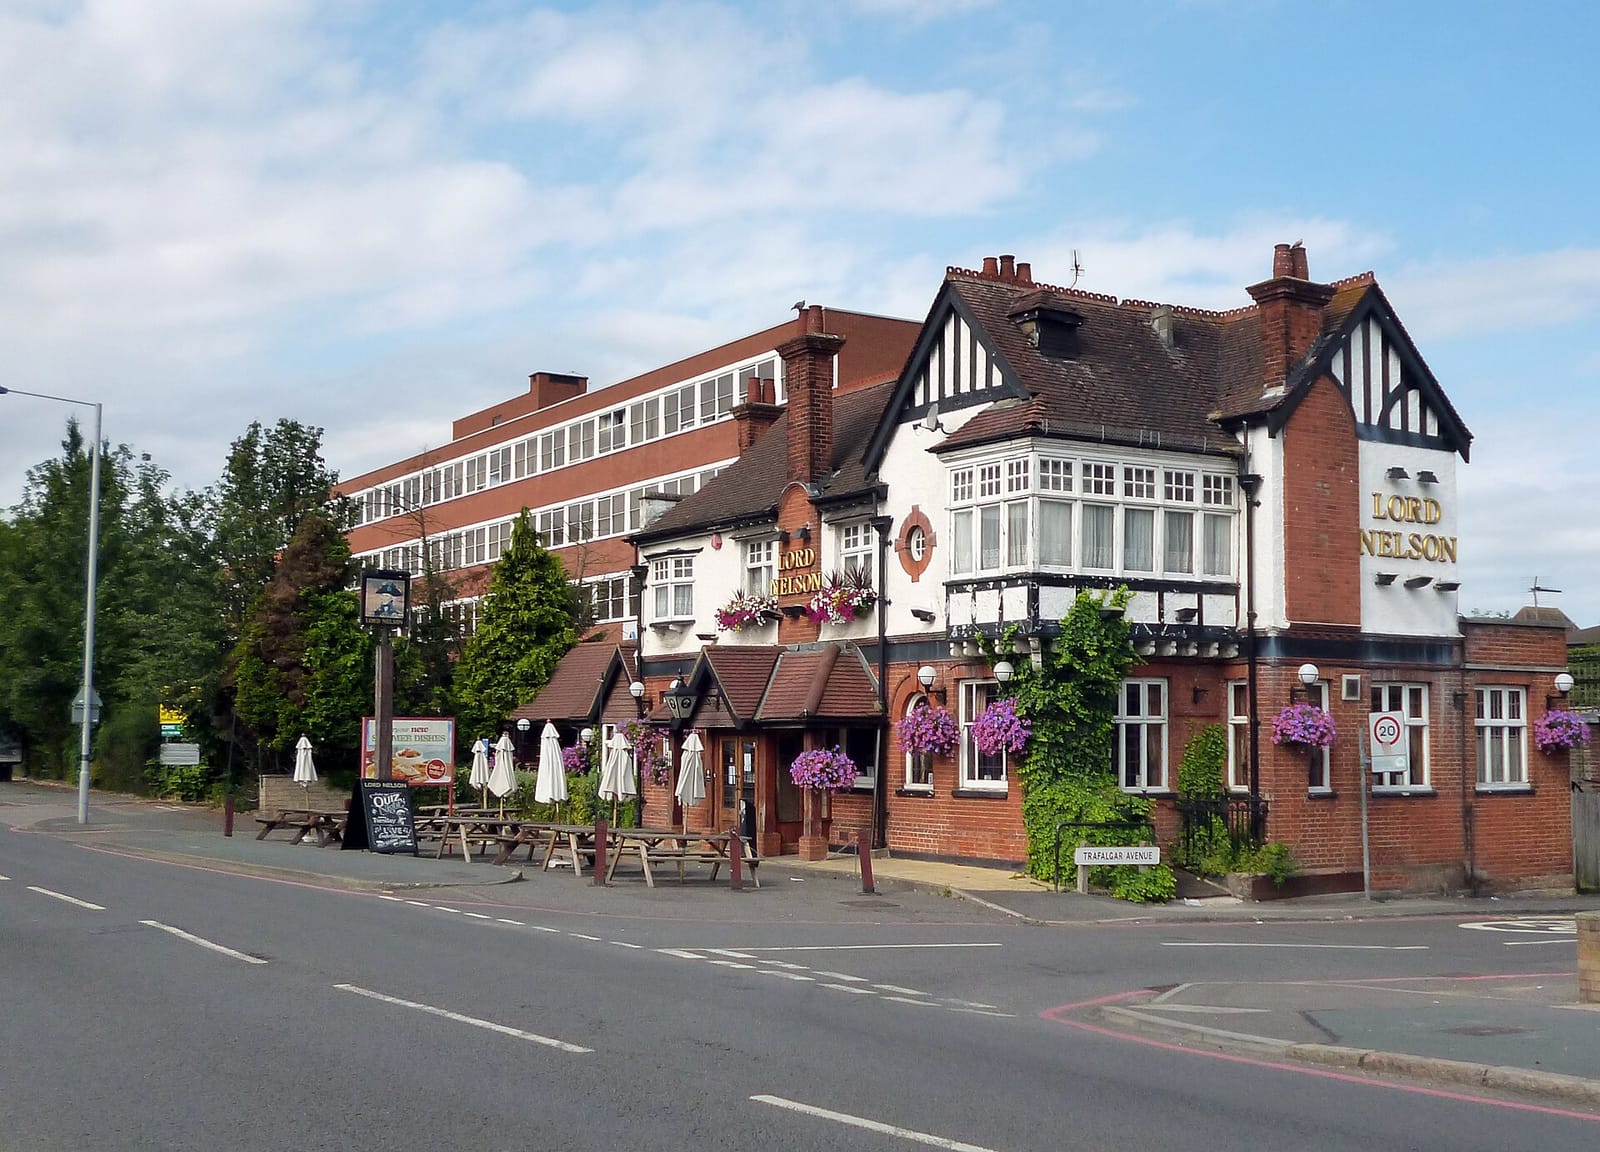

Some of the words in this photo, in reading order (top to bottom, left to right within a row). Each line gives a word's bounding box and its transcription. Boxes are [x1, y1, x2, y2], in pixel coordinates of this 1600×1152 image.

[1372, 491, 1441, 524] LORD
[1359, 528, 1457, 563] NELSON
[778, 548, 815, 571] LORD
[769, 572, 822, 597] NELSON
[372, 734, 413, 742] SMER
[414, 734, 446, 742] DISHES
[1379, 725, 1395, 737] 20
[1083, 851, 1123, 861] TRAFALGAR
[1126, 851, 1153, 860] AVENUE
